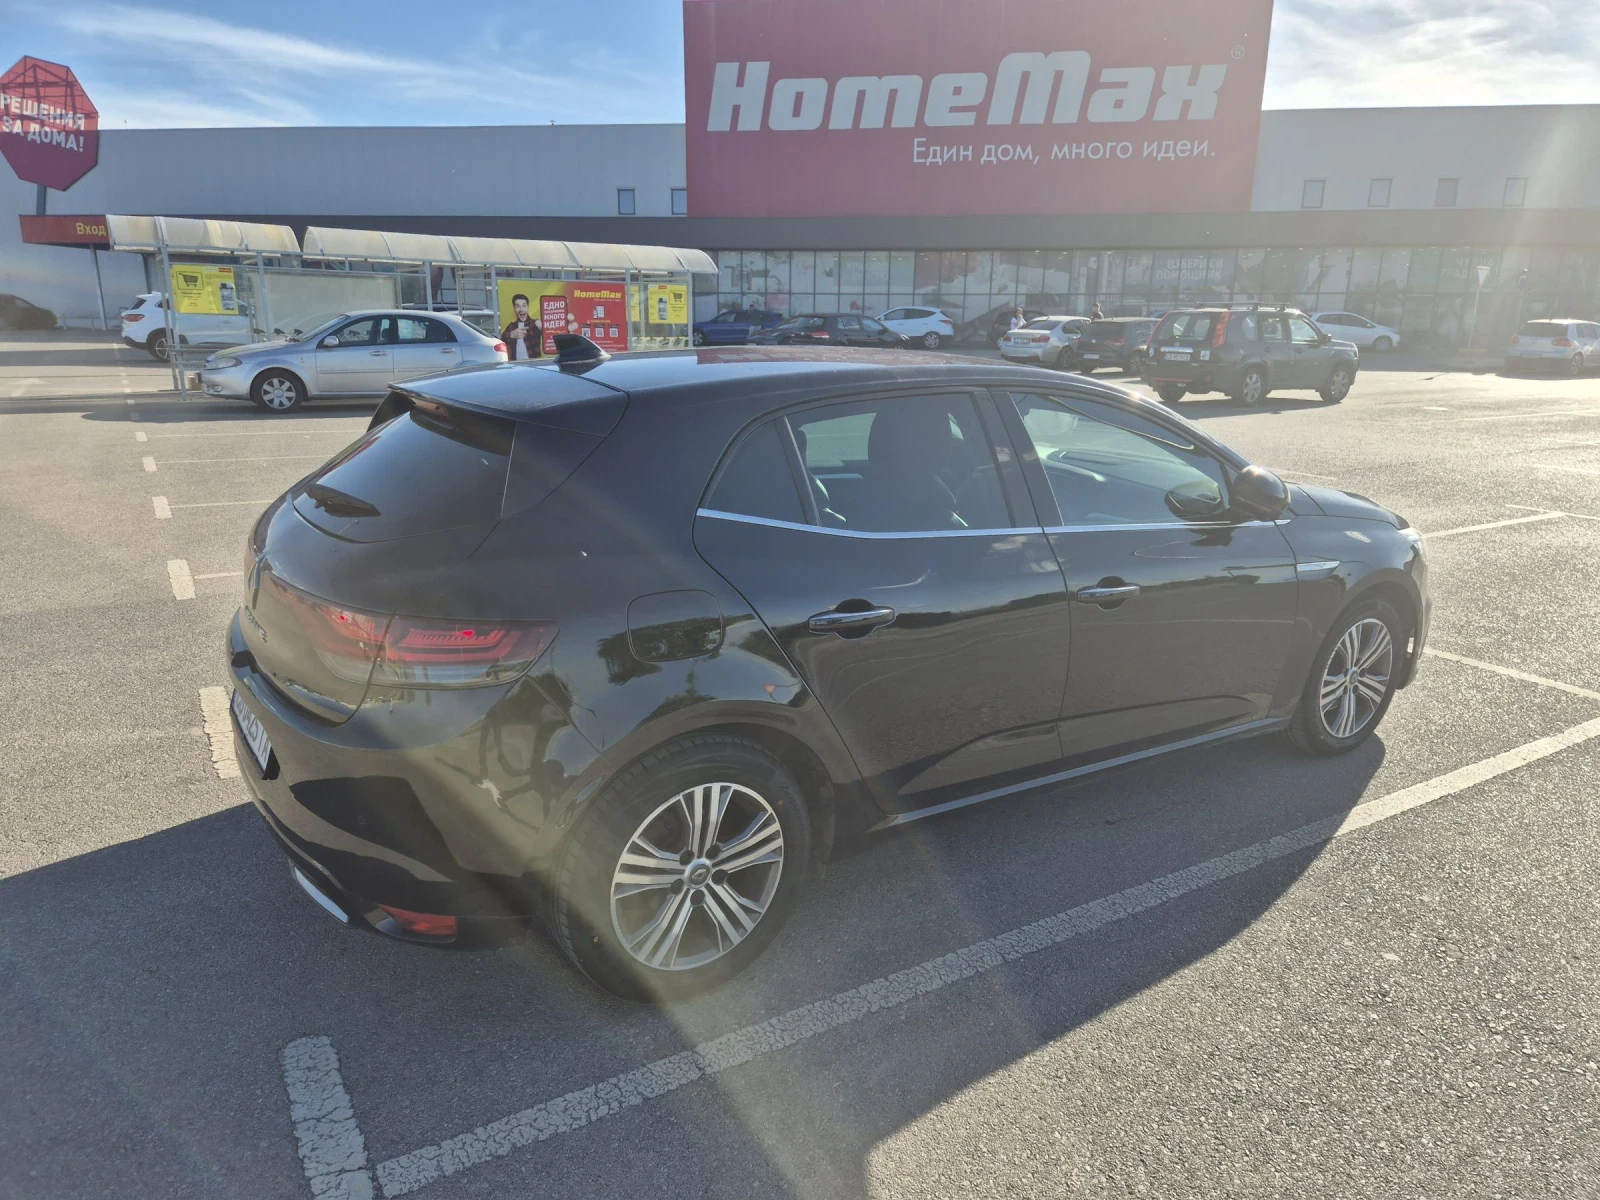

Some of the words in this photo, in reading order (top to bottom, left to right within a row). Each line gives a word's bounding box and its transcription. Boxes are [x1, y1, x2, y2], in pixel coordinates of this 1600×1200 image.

[706, 50, 1228, 132] HomeMax
[0, 93, 85, 131] РЕШЕНИЯ
[2, 115, 24, 136] ЗА
[27, 121, 84, 152] ДОМА!
[912, 137, 973, 166] Един
[980, 145, 1040, 165] дом,
[1050, 140, 1134, 161] много
[1143, 138, 1216, 162] идеи.
[75, 222, 107, 237] Вход
[574, 290, 622, 299] HomeMax
[543, 300, 566, 310] ЕДНО
[543, 313, 566, 321] МНОГО
[543, 321, 566, 329] ИДЕИ
